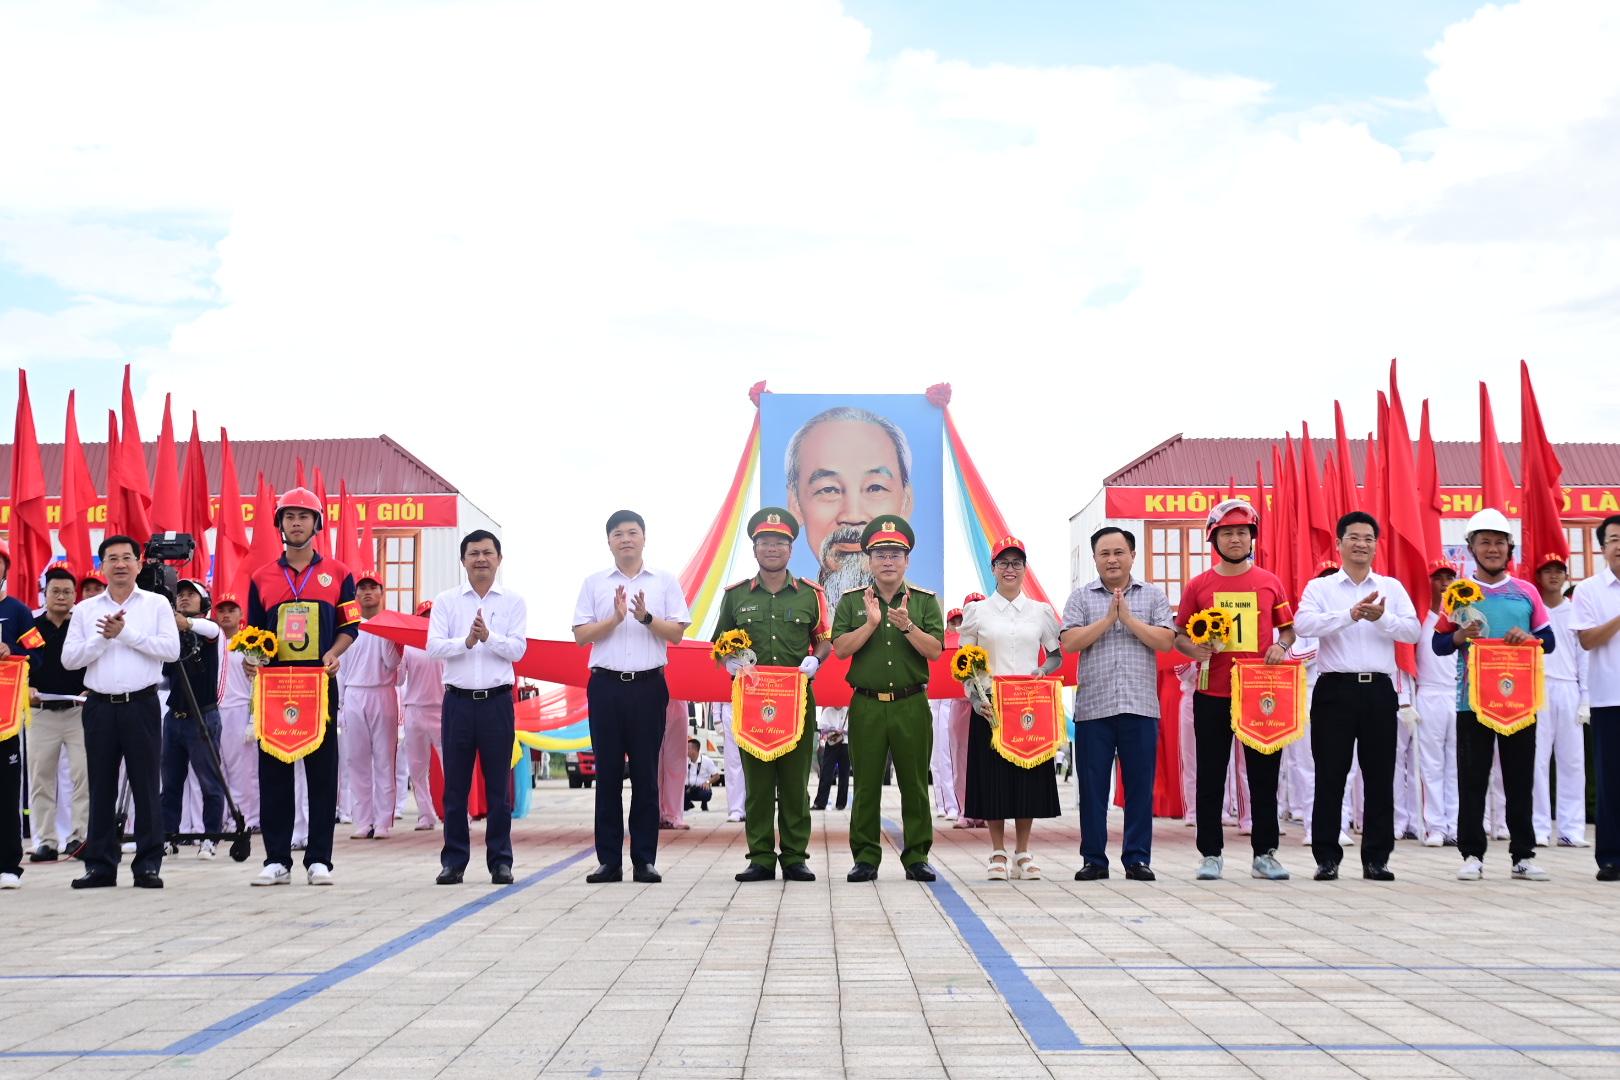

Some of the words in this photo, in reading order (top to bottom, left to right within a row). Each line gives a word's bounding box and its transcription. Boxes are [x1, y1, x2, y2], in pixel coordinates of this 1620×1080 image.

[377, 498, 424, 521] GIỎI
[1000, 537, 1019, 547] 114
[1545, 552, 1561, 562] 114
[1322, 560, 1338, 569] 114
[361, 570, 375, 578] 114
[1232, 613, 1242, 643] 1
